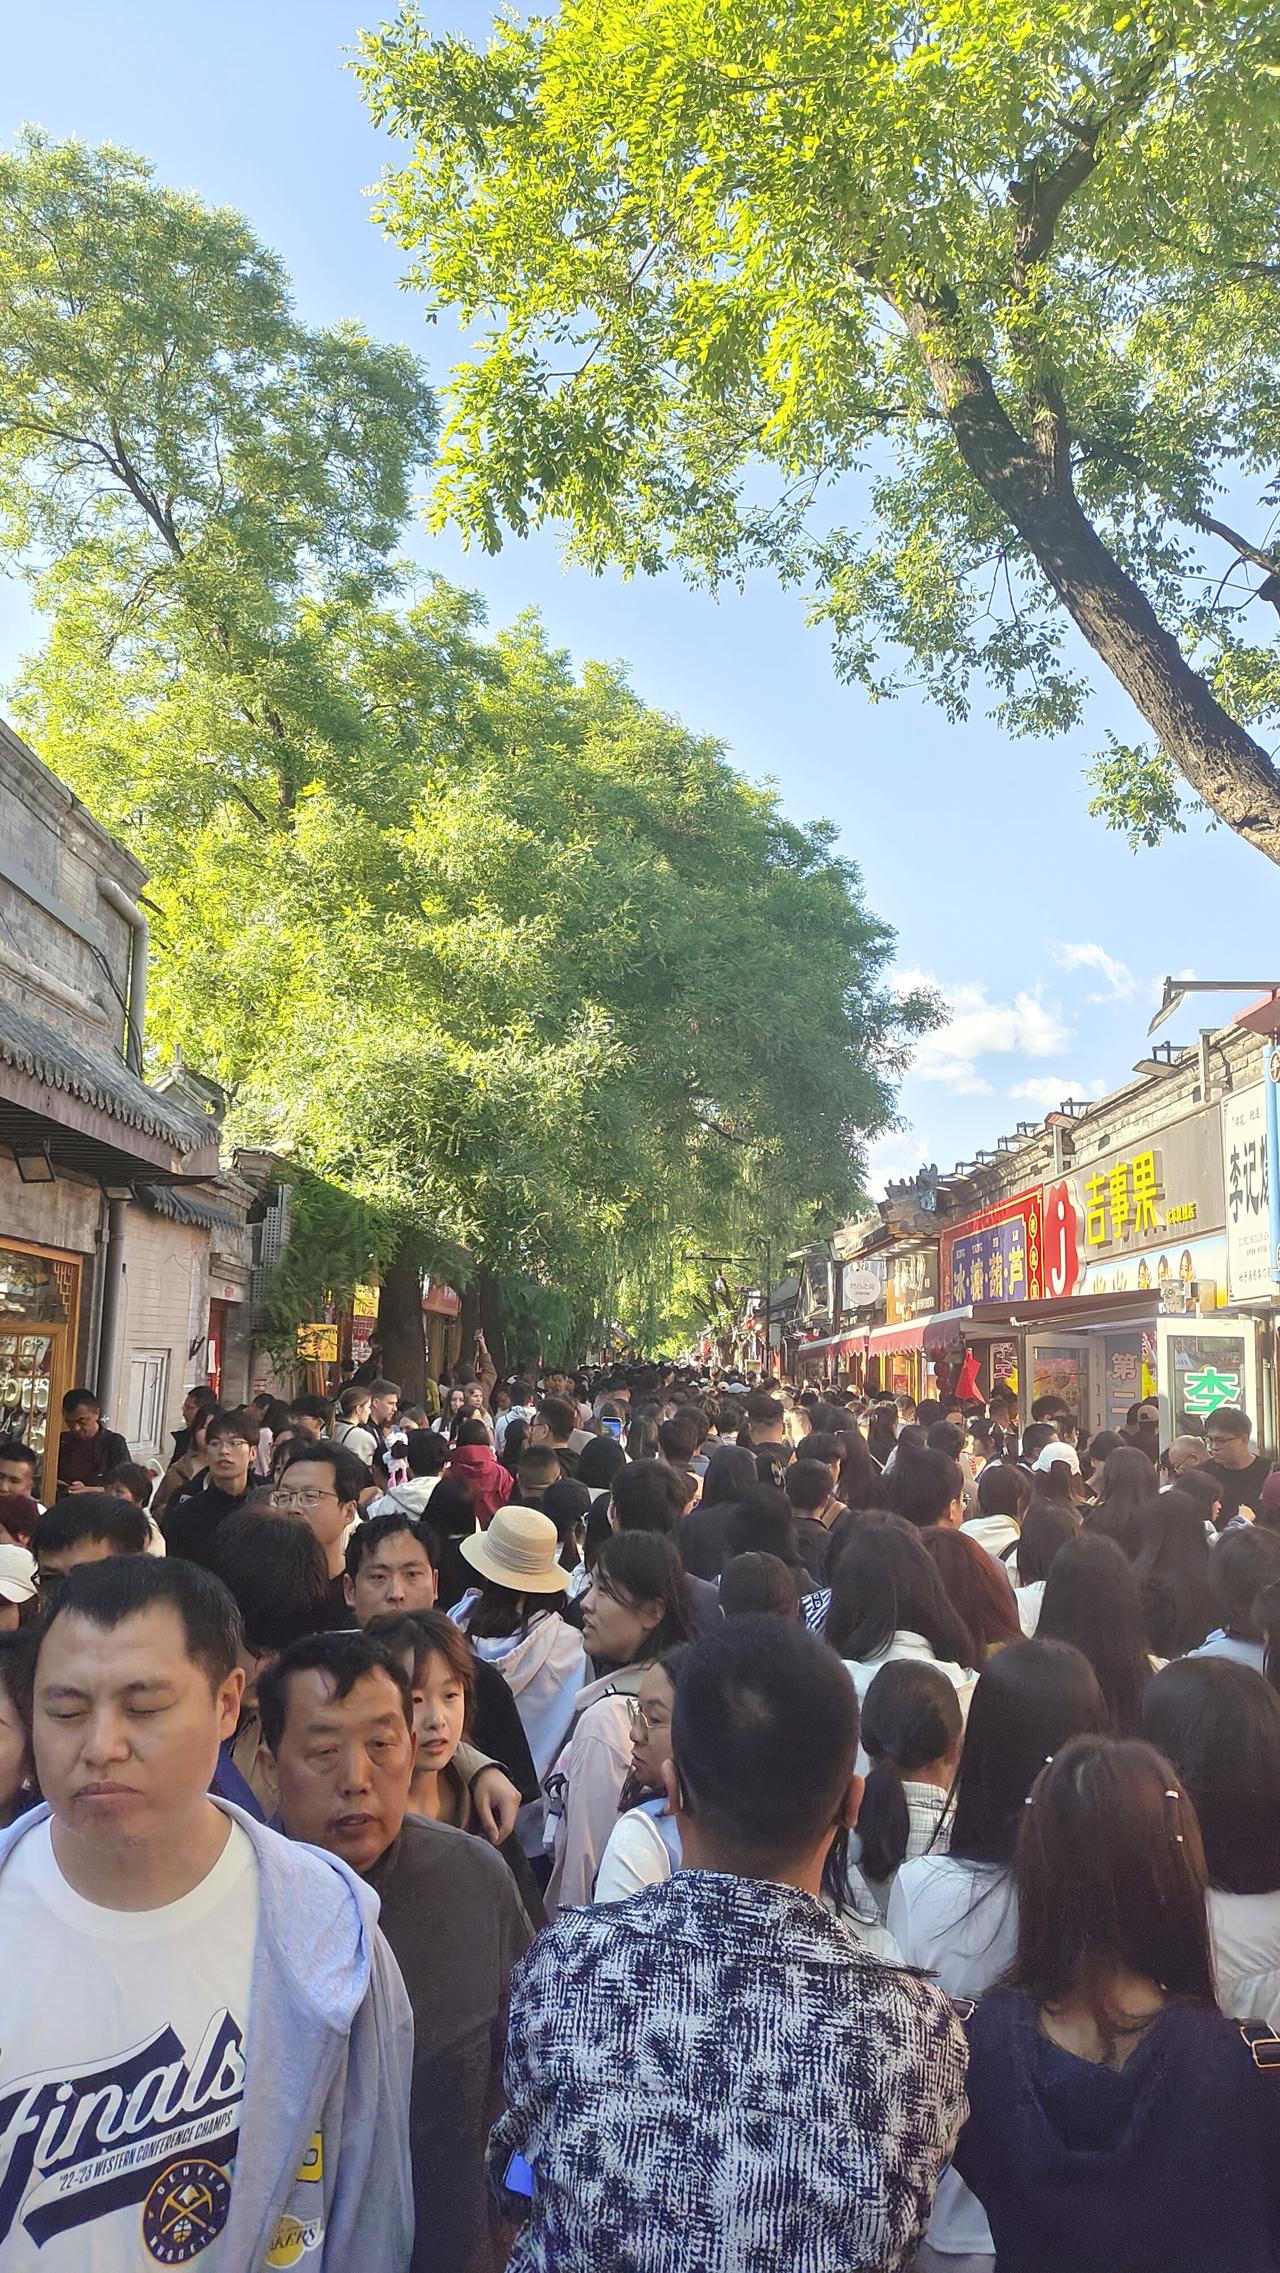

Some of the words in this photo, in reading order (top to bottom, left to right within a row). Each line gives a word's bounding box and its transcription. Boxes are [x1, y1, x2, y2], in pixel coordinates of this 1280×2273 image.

[1084, 1150, 1158, 1247] 吉事果
[0, 2007, 247, 2178] Finals
[93, 2155, 137, 2180] WESTERN
[136, 2127, 196, 2164] CONFERENCE
[194, 2109, 234, 2141] CHAMPS
[157, 2165, 226, 2195] DENVER
